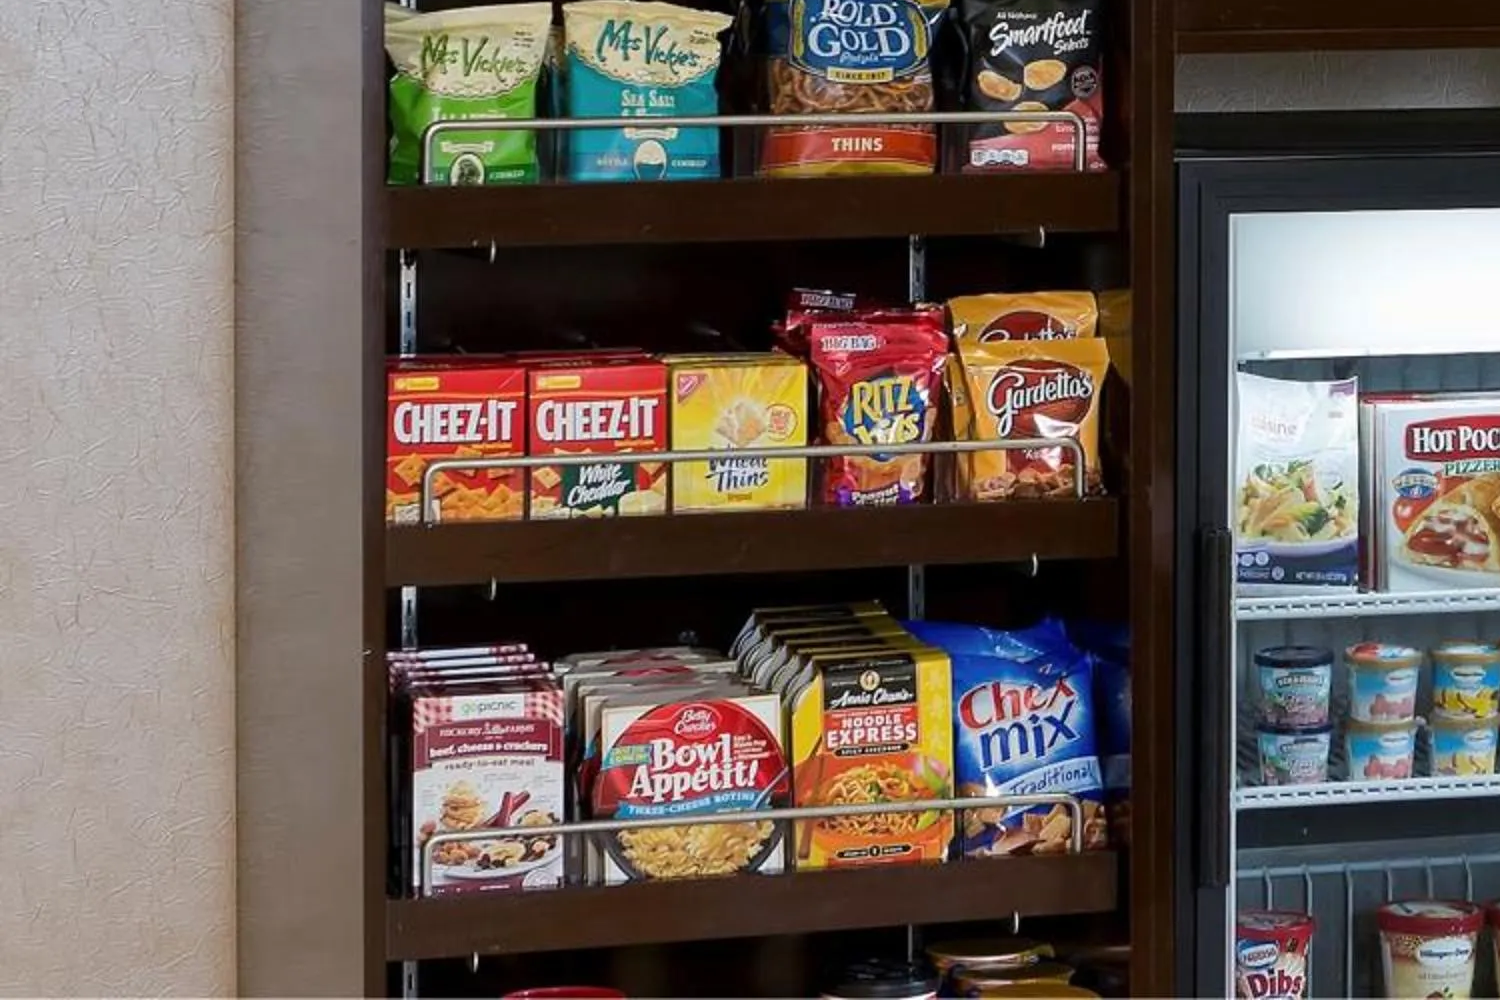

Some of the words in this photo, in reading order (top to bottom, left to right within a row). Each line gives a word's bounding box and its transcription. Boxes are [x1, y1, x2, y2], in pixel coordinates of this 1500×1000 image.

[808, 23, 911, 58] GOLD
[989, 9, 1088, 56] Smartfood
[644, 25, 700, 76] Vickie's
[832, 137, 883, 153] THINS
[852, 374, 914, 424] RITZ
[987, 372, 1092, 437] Gardetto's
[393, 399, 517, 443] CHEEZ-IT
[536, 397, 659, 440] CHEEZ-IT
[1413, 427, 1457, 453] HOT
[579, 463, 622, 484] White
[705, 470, 769, 491] Thins
[567, 480, 630, 506] Cheddar
[683, 709, 712, 722] Betty
[959, 676, 1077, 730] Chex
[827, 723, 917, 748] EXPRESS
[842, 713, 902, 729] NOODLE
[979, 701, 1082, 769] mix
[651, 733, 732, 771] Bowl
[1010, 763, 1096, 797] Traditional
[1246, 969, 1303, 998] Dibs
